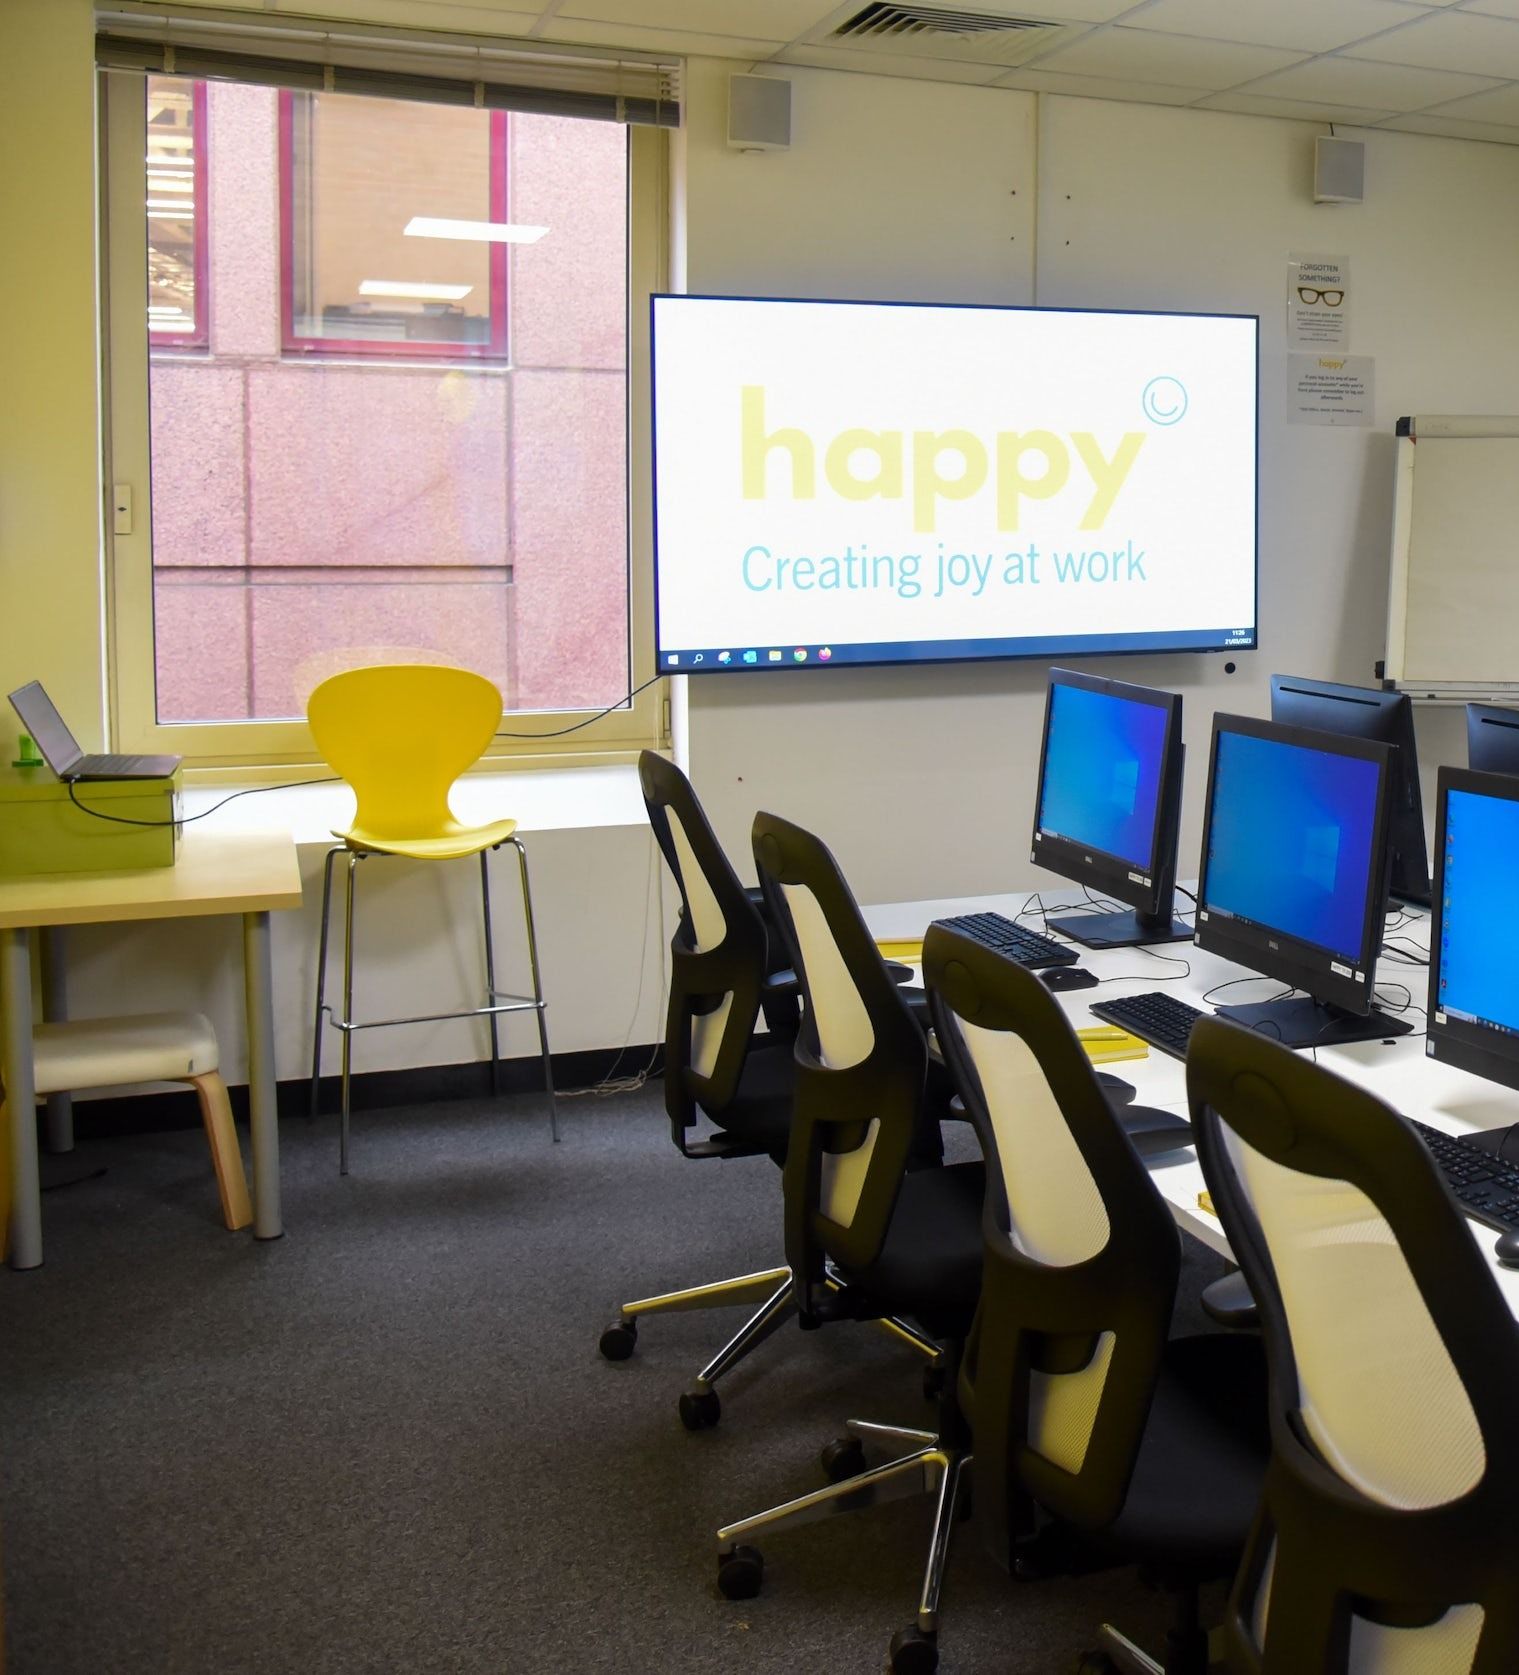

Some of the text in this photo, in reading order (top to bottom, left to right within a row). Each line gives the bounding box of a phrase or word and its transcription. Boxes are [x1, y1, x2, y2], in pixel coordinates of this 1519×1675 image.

[1300, 263, 1338, 272] FORGOTTEN
[1298, 274, 1341, 283] SOMETHING?
[1318, 358, 1345, 369] happy
[741, 385, 1147, 532] happy
[742, 540, 1147, 598] Creating joy at work
